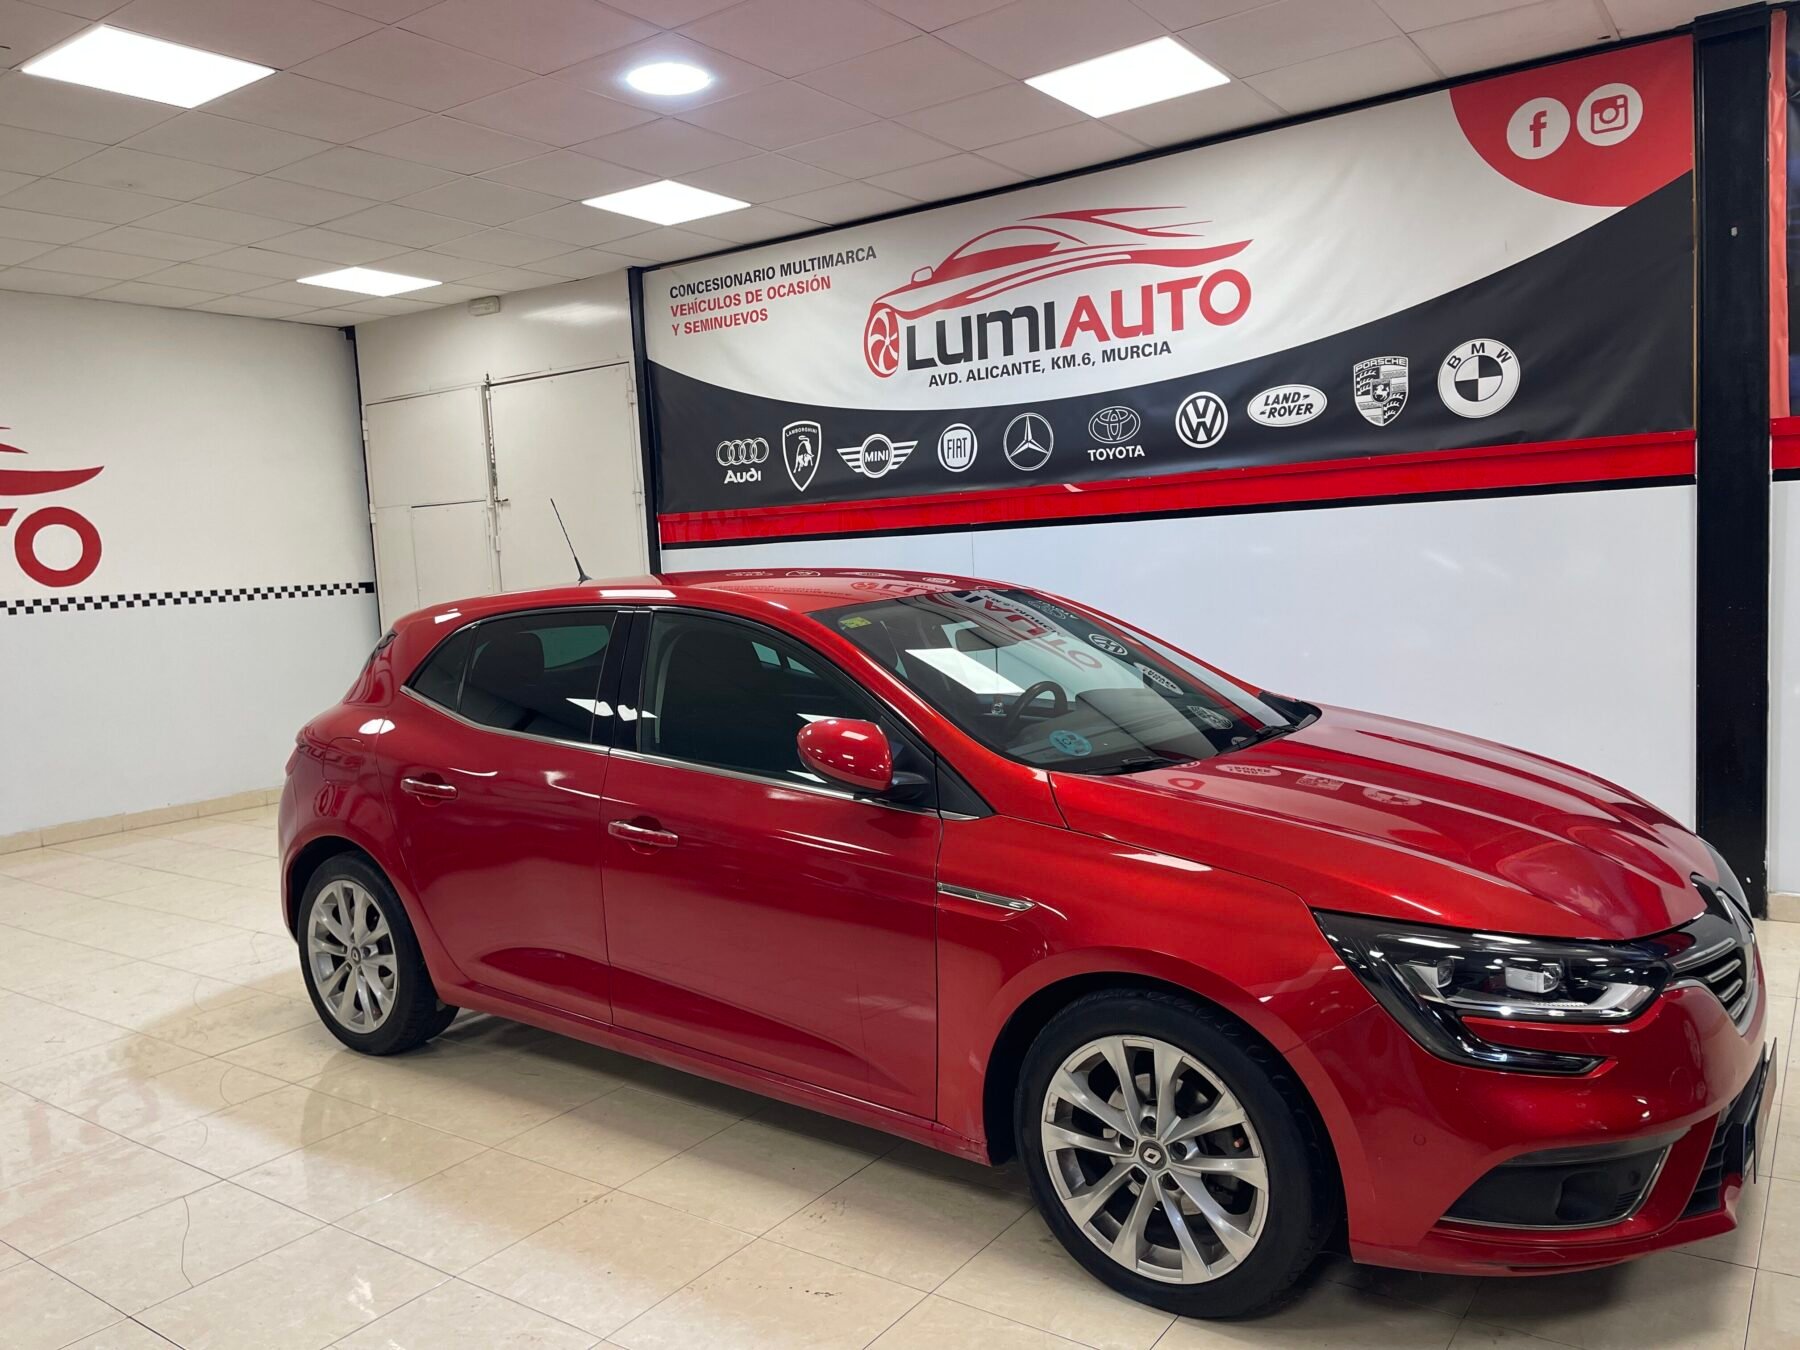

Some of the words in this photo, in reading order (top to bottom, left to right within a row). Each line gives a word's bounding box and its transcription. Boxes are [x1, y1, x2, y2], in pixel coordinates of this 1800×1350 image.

[669, 266, 776, 299] CONCESIONARIO
[780, 245, 877, 278] MULTIMARCA
[670, 293, 742, 318] VEHÍCULOS
[745, 288, 763, 305] DE
[766, 274, 832, 300] OCASIÓN
[671, 323, 680, 336] Y
[684, 308, 769, 335] SEMINUEVOS
[928, 372, 962, 388] AVD.
[965, 359, 1046, 383] ALICANTE,
[1051, 352, 1096, 371] KM.6,
[1101, 340, 1172, 364] MURCIA
[1355, 356, 1408, 372] PORSCHE
[863, 449, 889, 463] MINI
[947, 436, 968, 460] FIAT
[1087, 445, 1146, 462] TOYOTA
[723, 467, 762, 484] Audi
